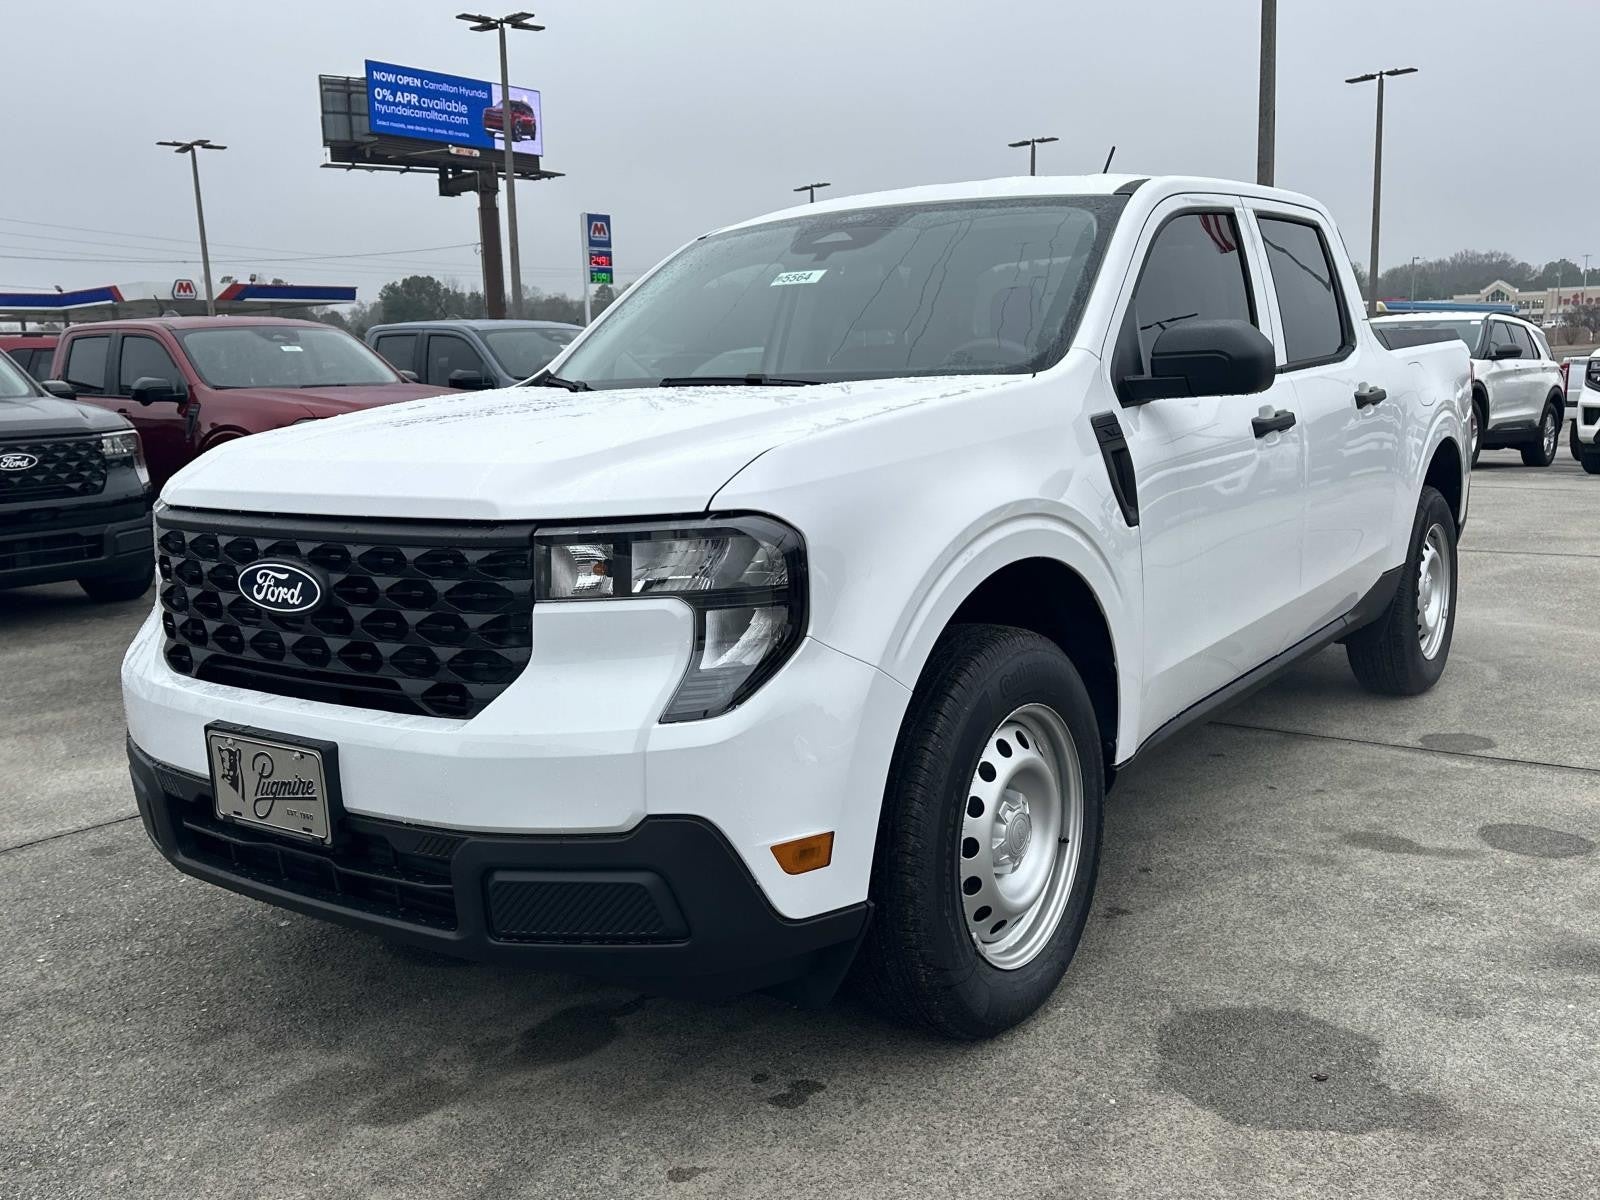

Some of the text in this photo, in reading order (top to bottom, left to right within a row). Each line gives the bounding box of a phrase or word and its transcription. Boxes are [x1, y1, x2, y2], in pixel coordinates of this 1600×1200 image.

[373, 70, 488, 99] NOW OPEN Carrollton Hyundai
[374, 87, 468, 114] 0% APR available
[375, 102, 469, 125] hyundaicarrollton.com
[177, 282, 194, 293] M
[782, 272, 813, 283] 5564
[0, 455, 29, 468] Ford
[253, 569, 303, 605] Ford
[252, 750, 318, 819] Pugmire
